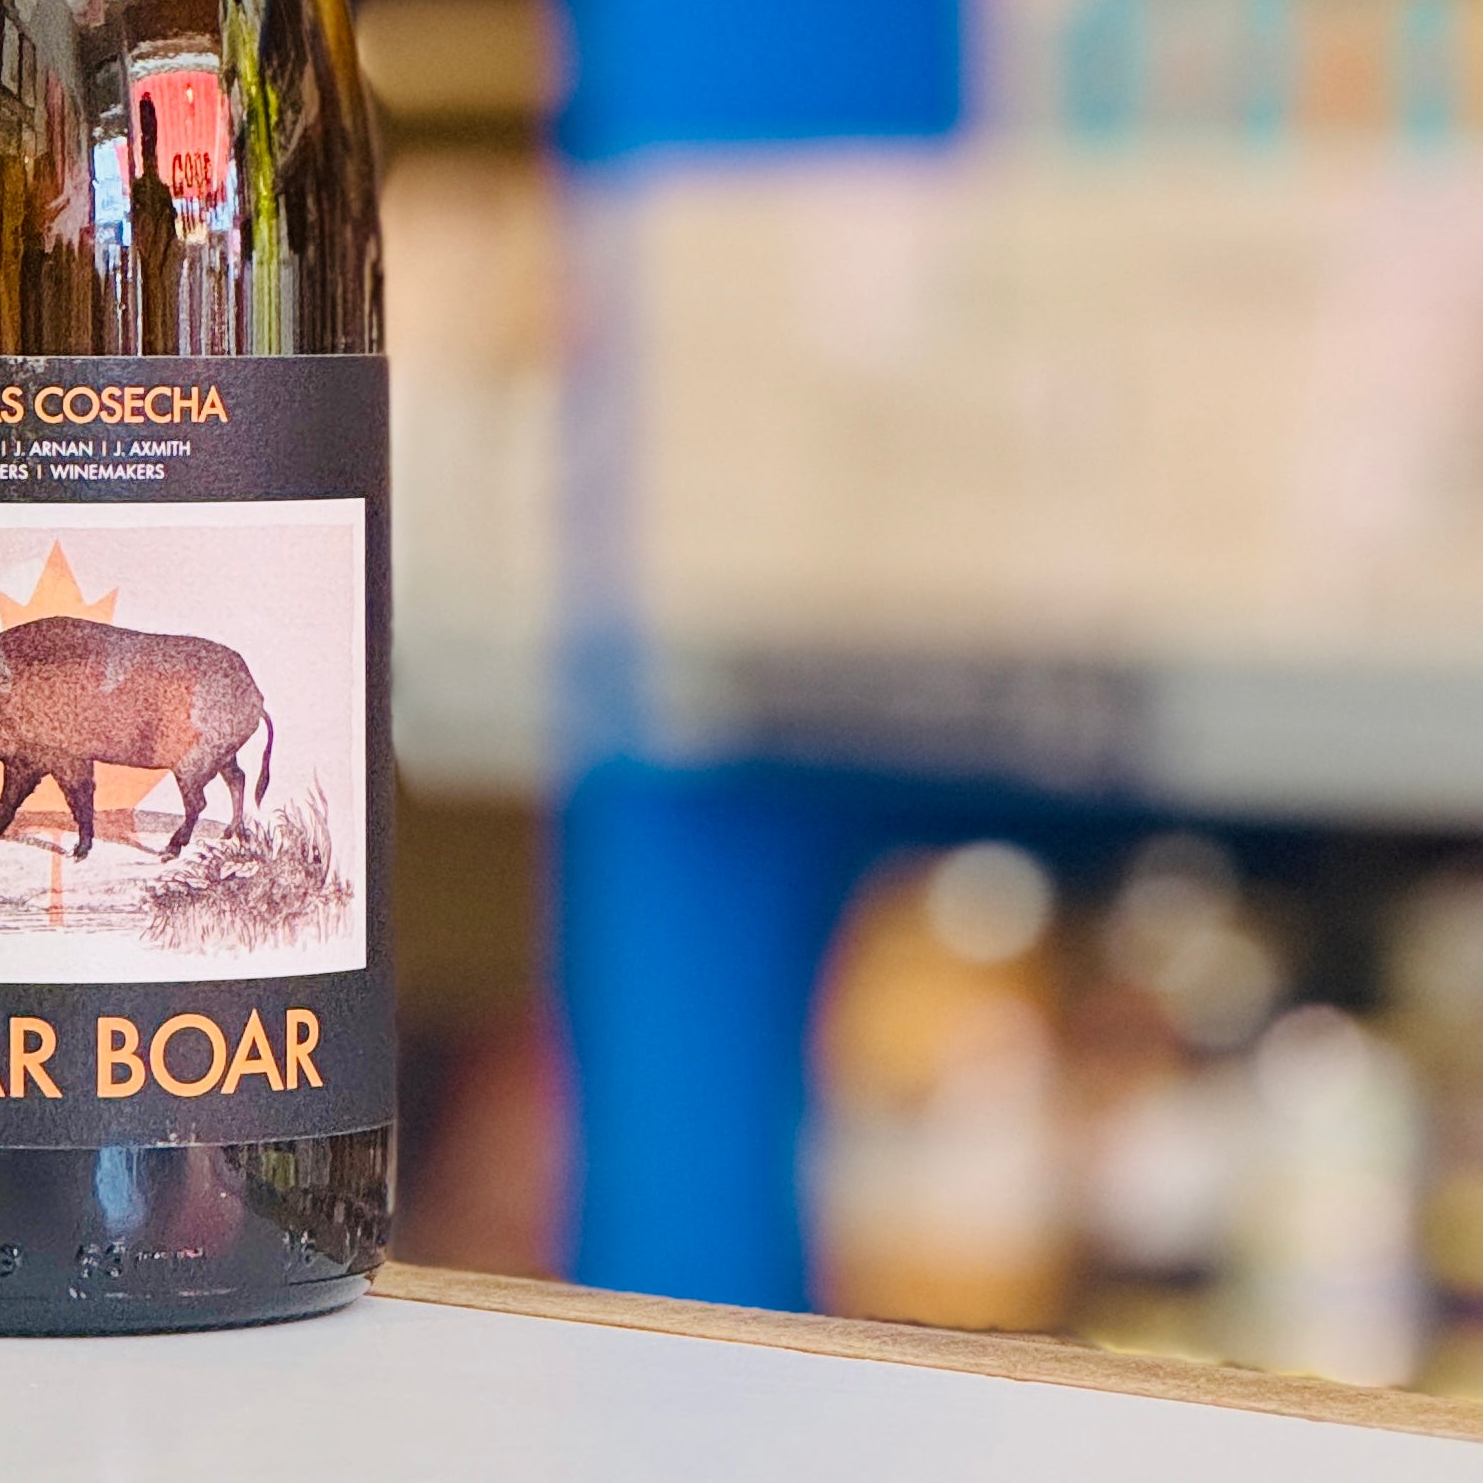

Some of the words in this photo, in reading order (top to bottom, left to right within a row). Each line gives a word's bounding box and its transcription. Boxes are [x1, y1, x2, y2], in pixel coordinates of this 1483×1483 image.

[33, 385, 229, 425] COSECHA
[14, 440, 26, 457] J.
[29, 440, 94, 458] ARNAN
[112, 440, 126, 458] J.
[128, 440, 191, 457] AXMITH
[49, 463, 165, 480] WINEMAKERS
[96, 1007, 324, 1099] BOAR
